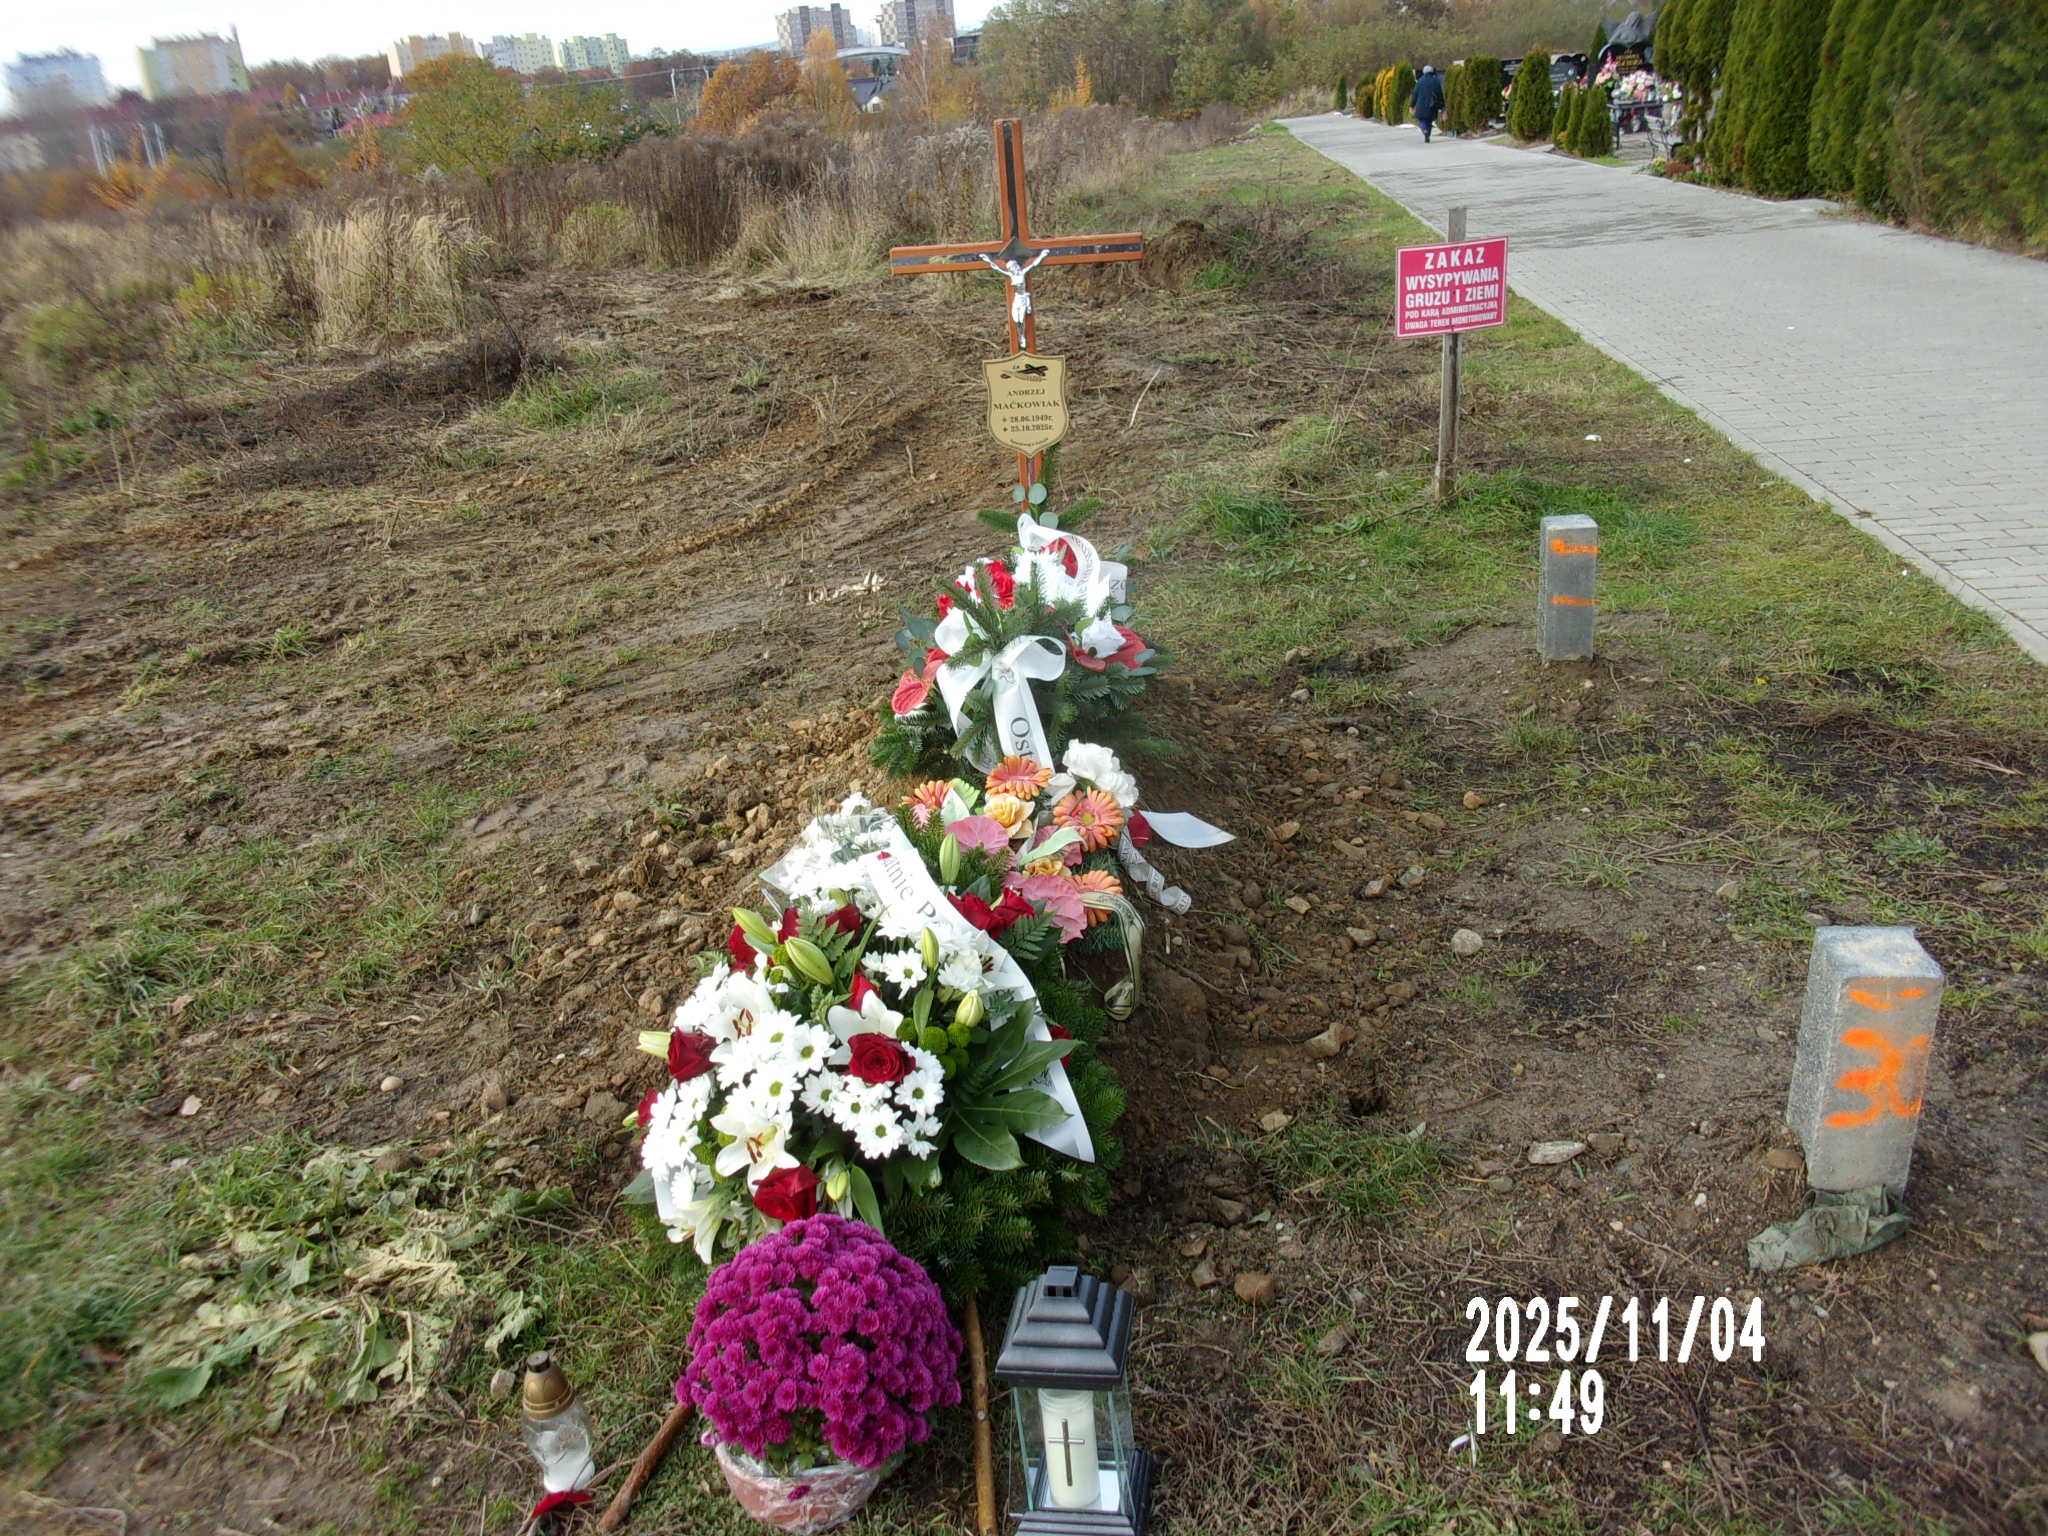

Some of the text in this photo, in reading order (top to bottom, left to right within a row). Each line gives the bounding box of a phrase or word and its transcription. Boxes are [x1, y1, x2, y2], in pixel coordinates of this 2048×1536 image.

[1424, 247, 1485, 270] ZAKAZ
[1405, 266, 1499, 291] WYSYPYWANIA
[1405, 284, 1499, 308] GRUZU I ZIEMI
[1405, 310, 1419, 319] POD
[1405, 320, 1428, 330] UWAGA
[1431, 318, 1450, 328] TEREN
[1008, 388, 1045, 397] ANDRZEJ
